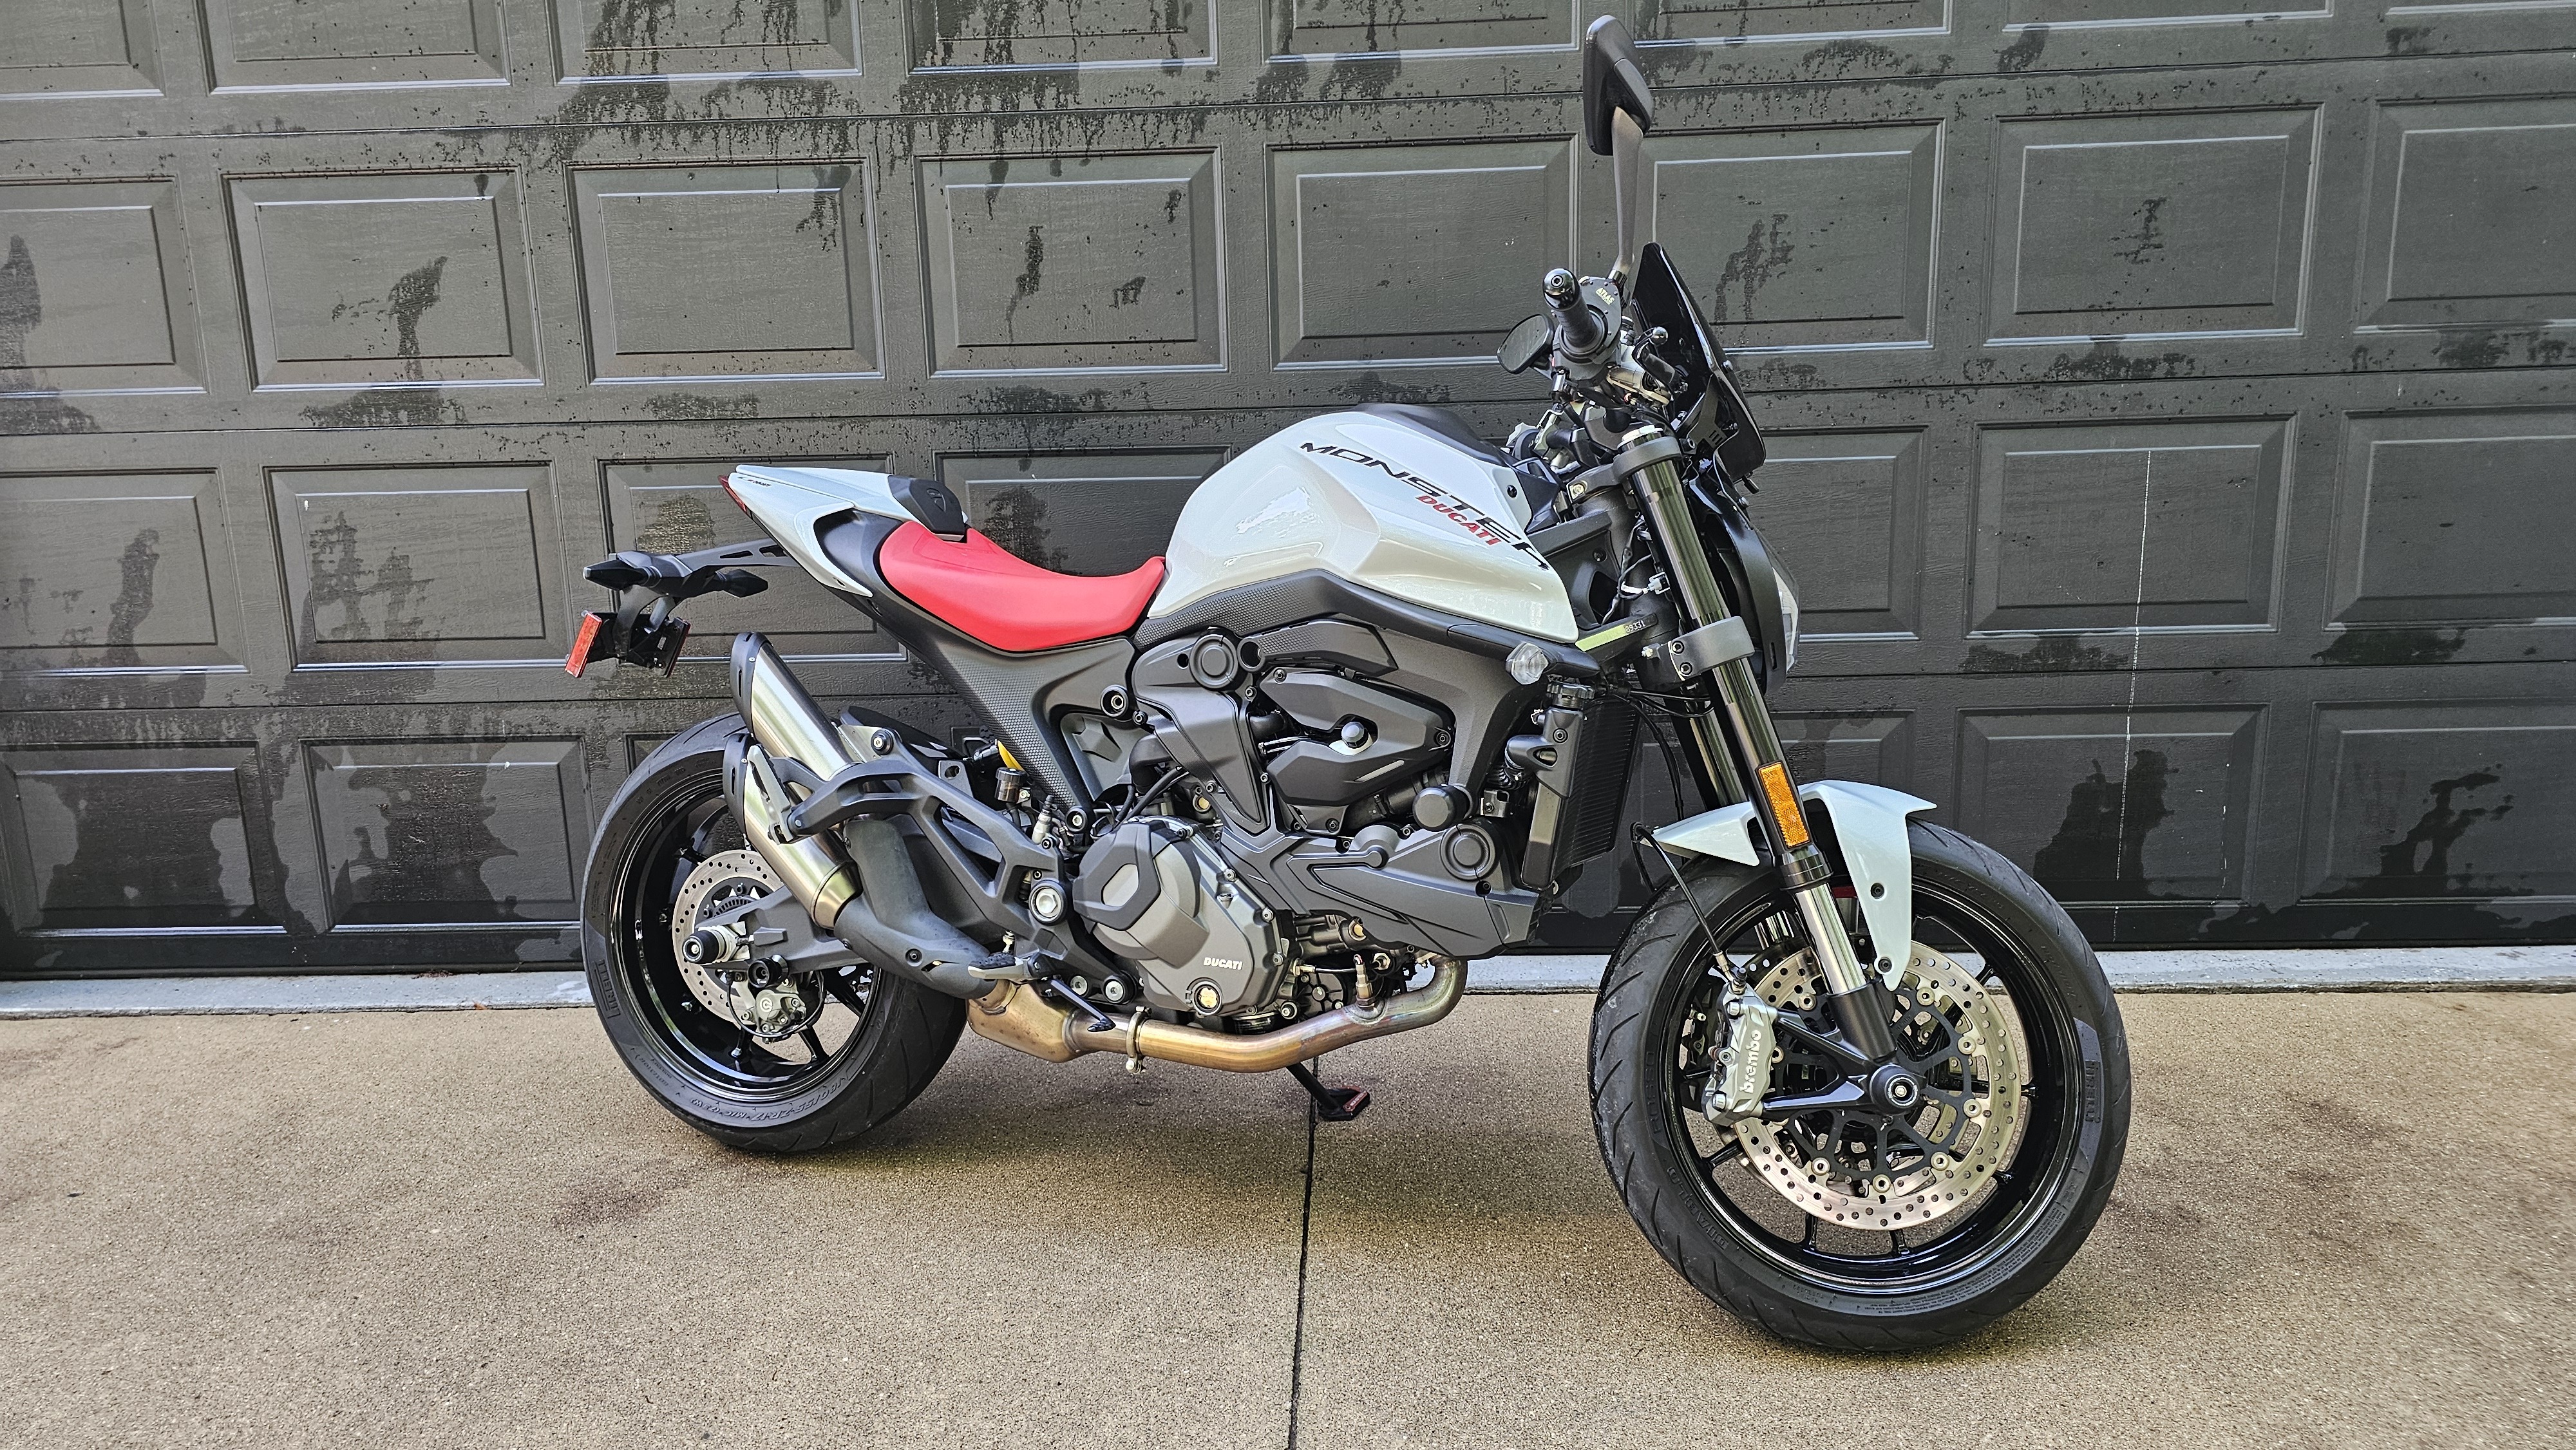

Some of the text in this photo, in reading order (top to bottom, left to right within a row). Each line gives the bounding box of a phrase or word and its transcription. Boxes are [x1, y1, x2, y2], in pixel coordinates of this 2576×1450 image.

[1596, 287, 1615, 303] ATLAS
[1416, 495, 1502, 545] DUCATI
[593, 959, 621, 1019] PIRELLI
[1203, 957, 1243, 970] DUCATI
[1739, 1030, 1762, 1093] brembo
[1667, 1167, 1729, 1244] DIABLO
